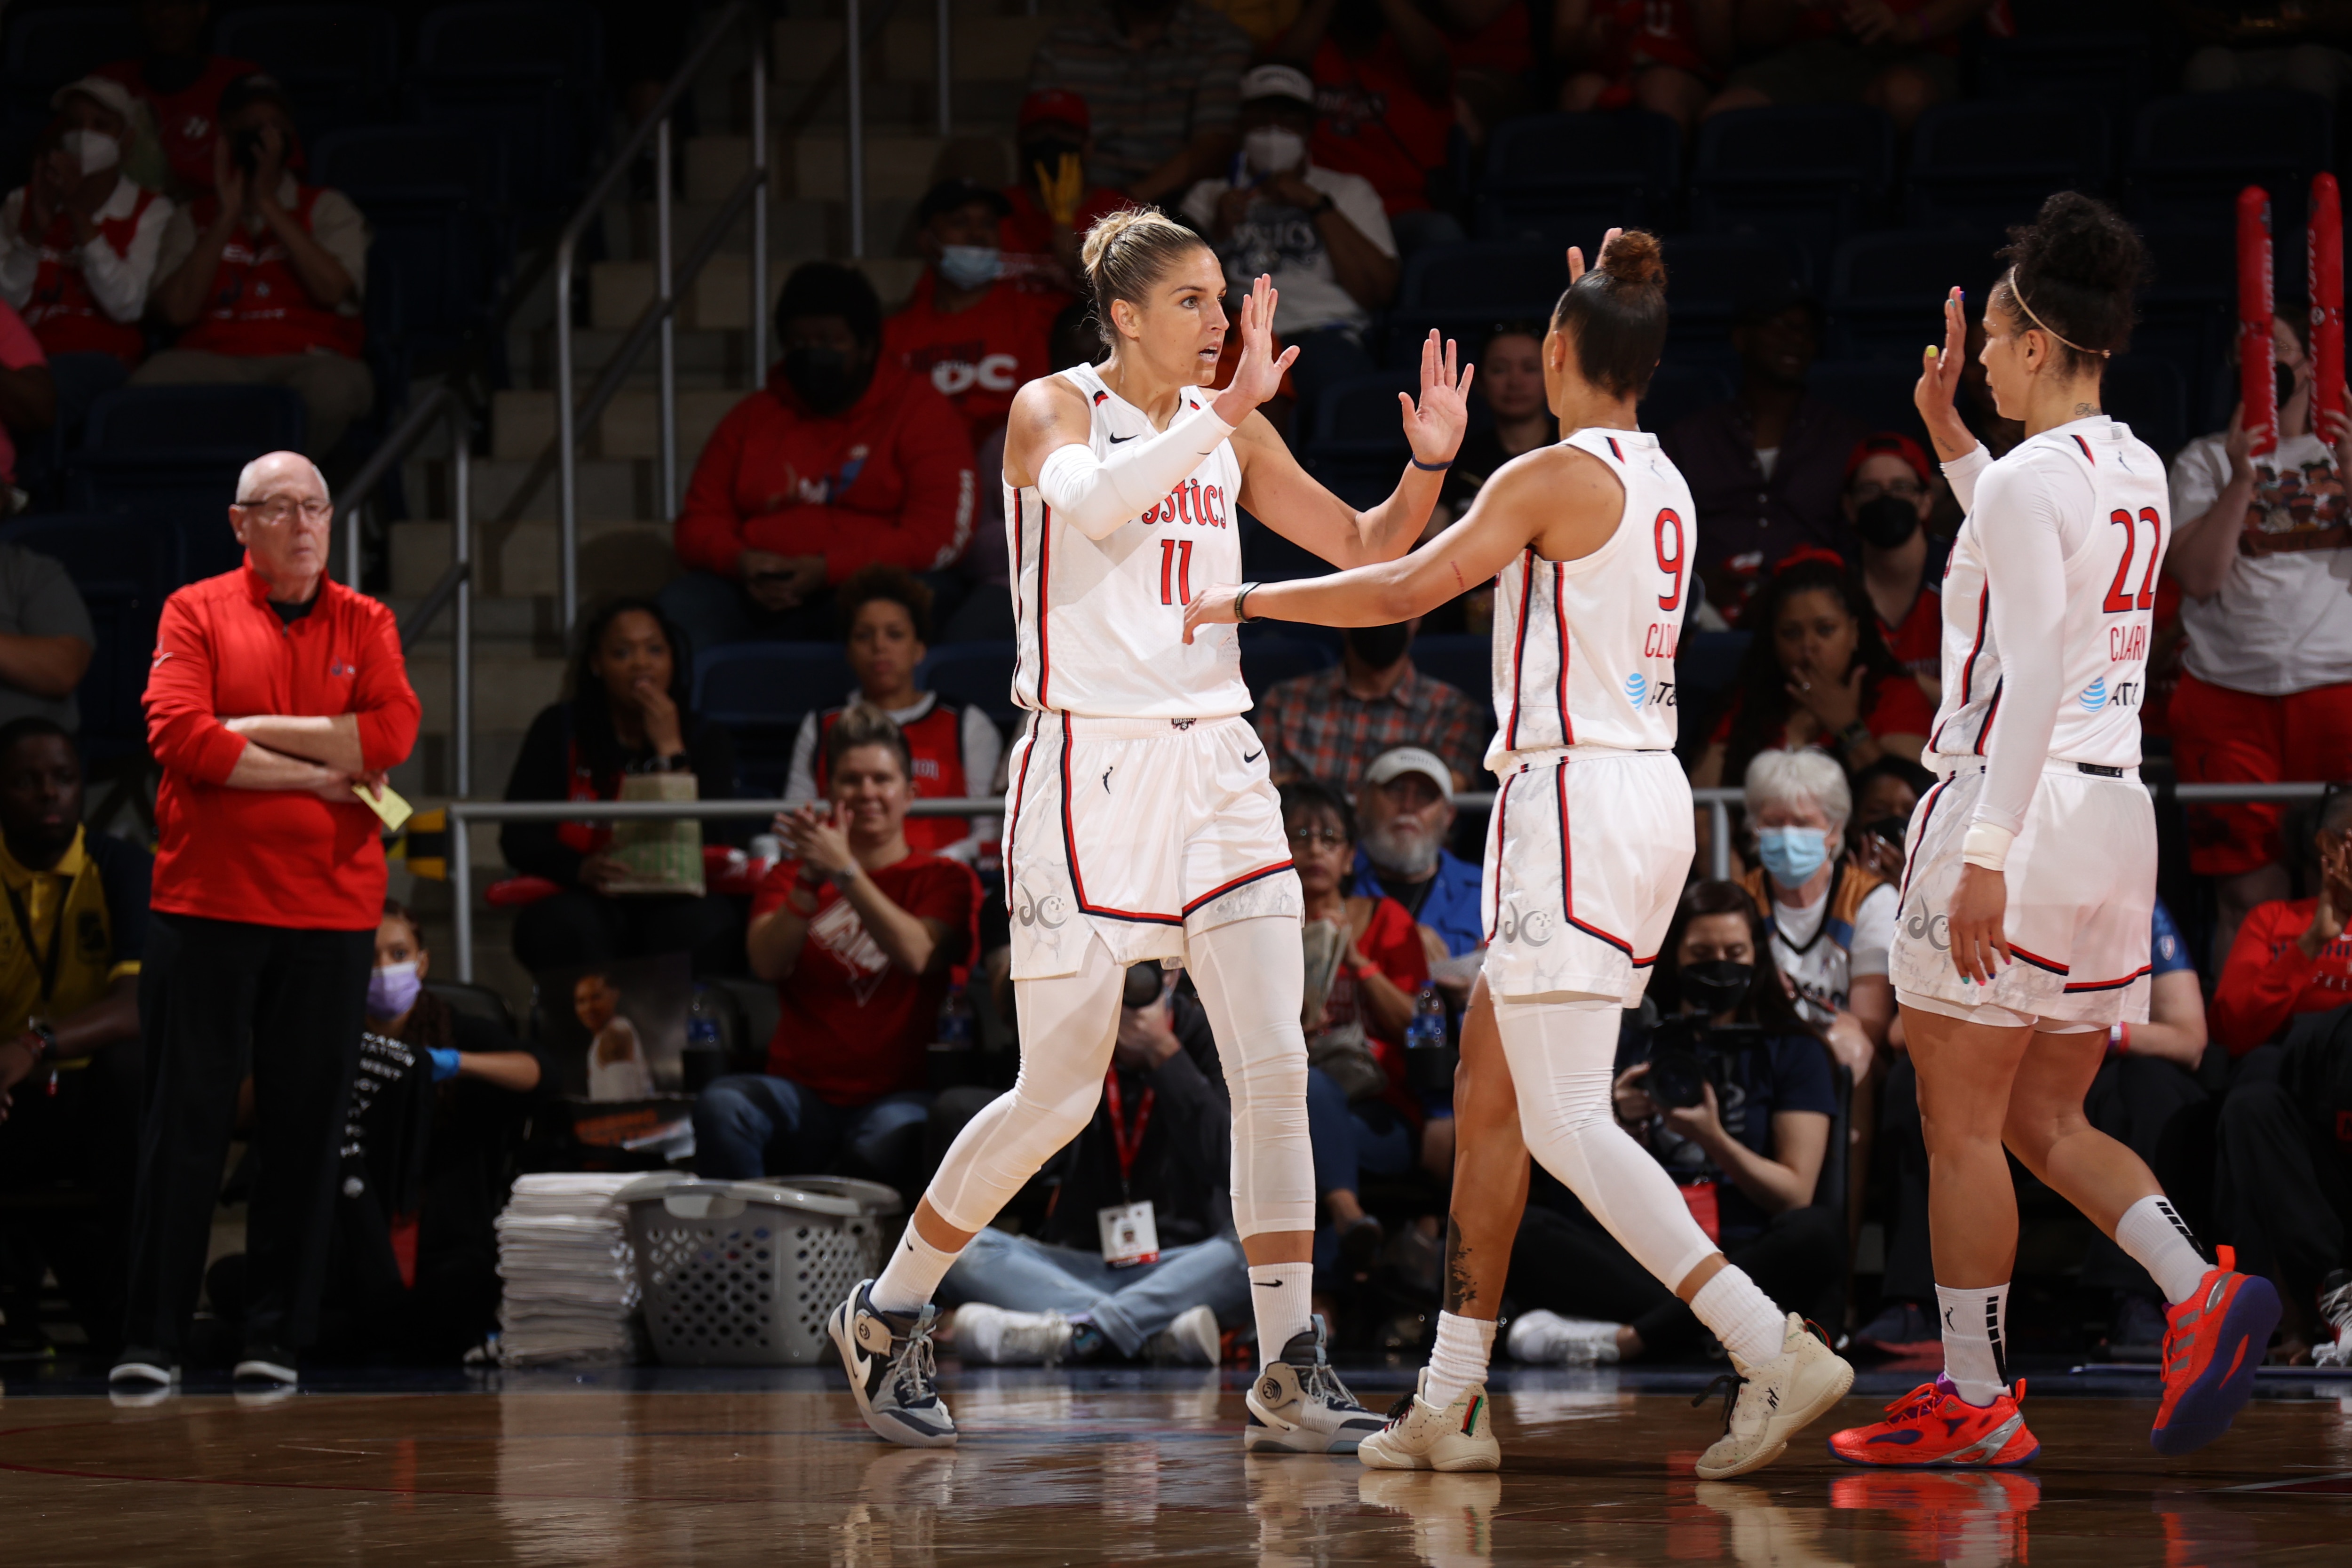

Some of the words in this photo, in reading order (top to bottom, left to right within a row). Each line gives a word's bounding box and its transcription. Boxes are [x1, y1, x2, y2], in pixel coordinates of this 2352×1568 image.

[1142, 478, 1227, 529] stics
[1161, 539, 1193, 605] 11
[1654, 508, 1684, 612] 9
[2103, 507, 2161, 613] 22
